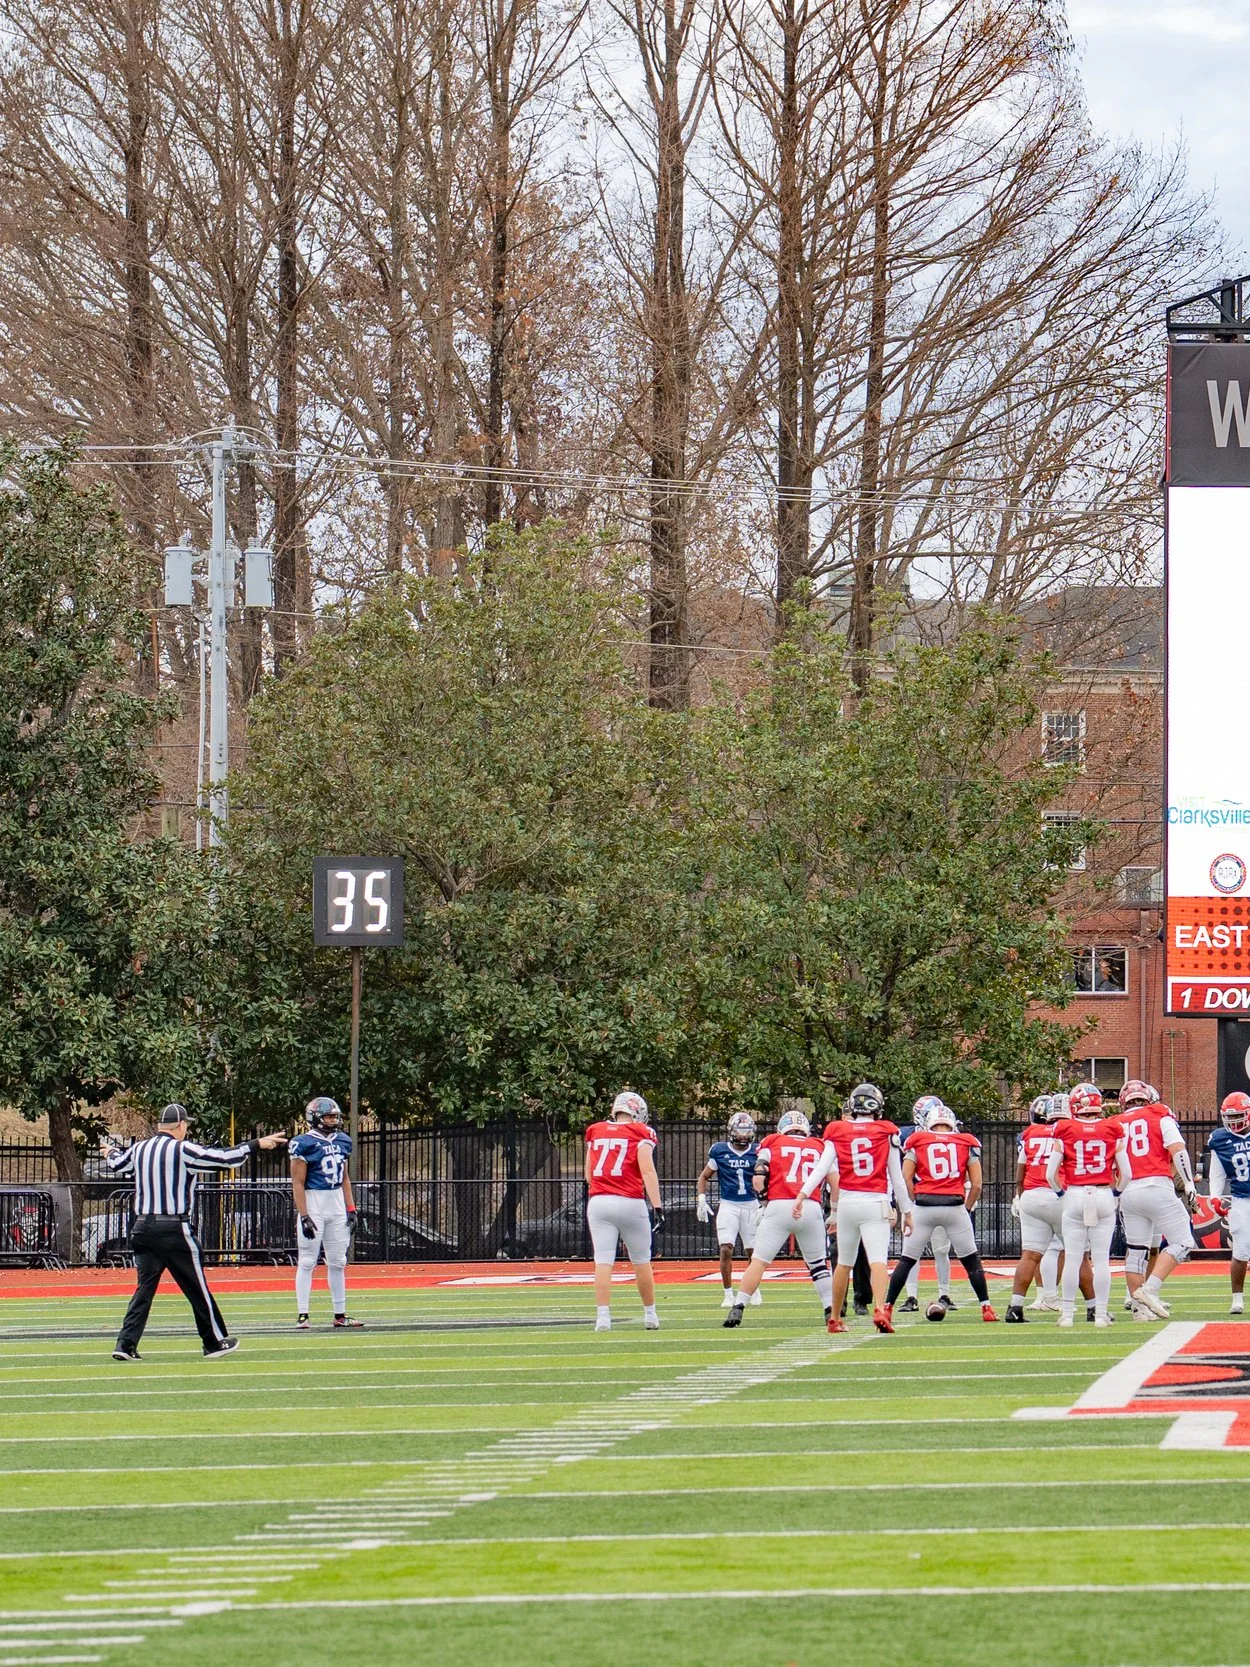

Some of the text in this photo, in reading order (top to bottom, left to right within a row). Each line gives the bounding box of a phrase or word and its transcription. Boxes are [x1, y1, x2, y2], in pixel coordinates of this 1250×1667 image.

[331, 871, 389, 932] 35
[1175, 925, 1248, 948] EAST
[1179, 988, 1193, 1009] 1
[322, 1144, 342, 1155] TACA
[593, 1138, 629, 1177] 77
[728, 1159, 751, 1168] TACA
[780, 1146, 821, 1183] 72
[850, 1137, 875, 1177] 6
[927, 1142, 960, 1181] 61
[1073, 1140, 1107, 1175] 13
[320, 1153, 346, 1185] 97
[736, 1168, 747, 1195] 1
